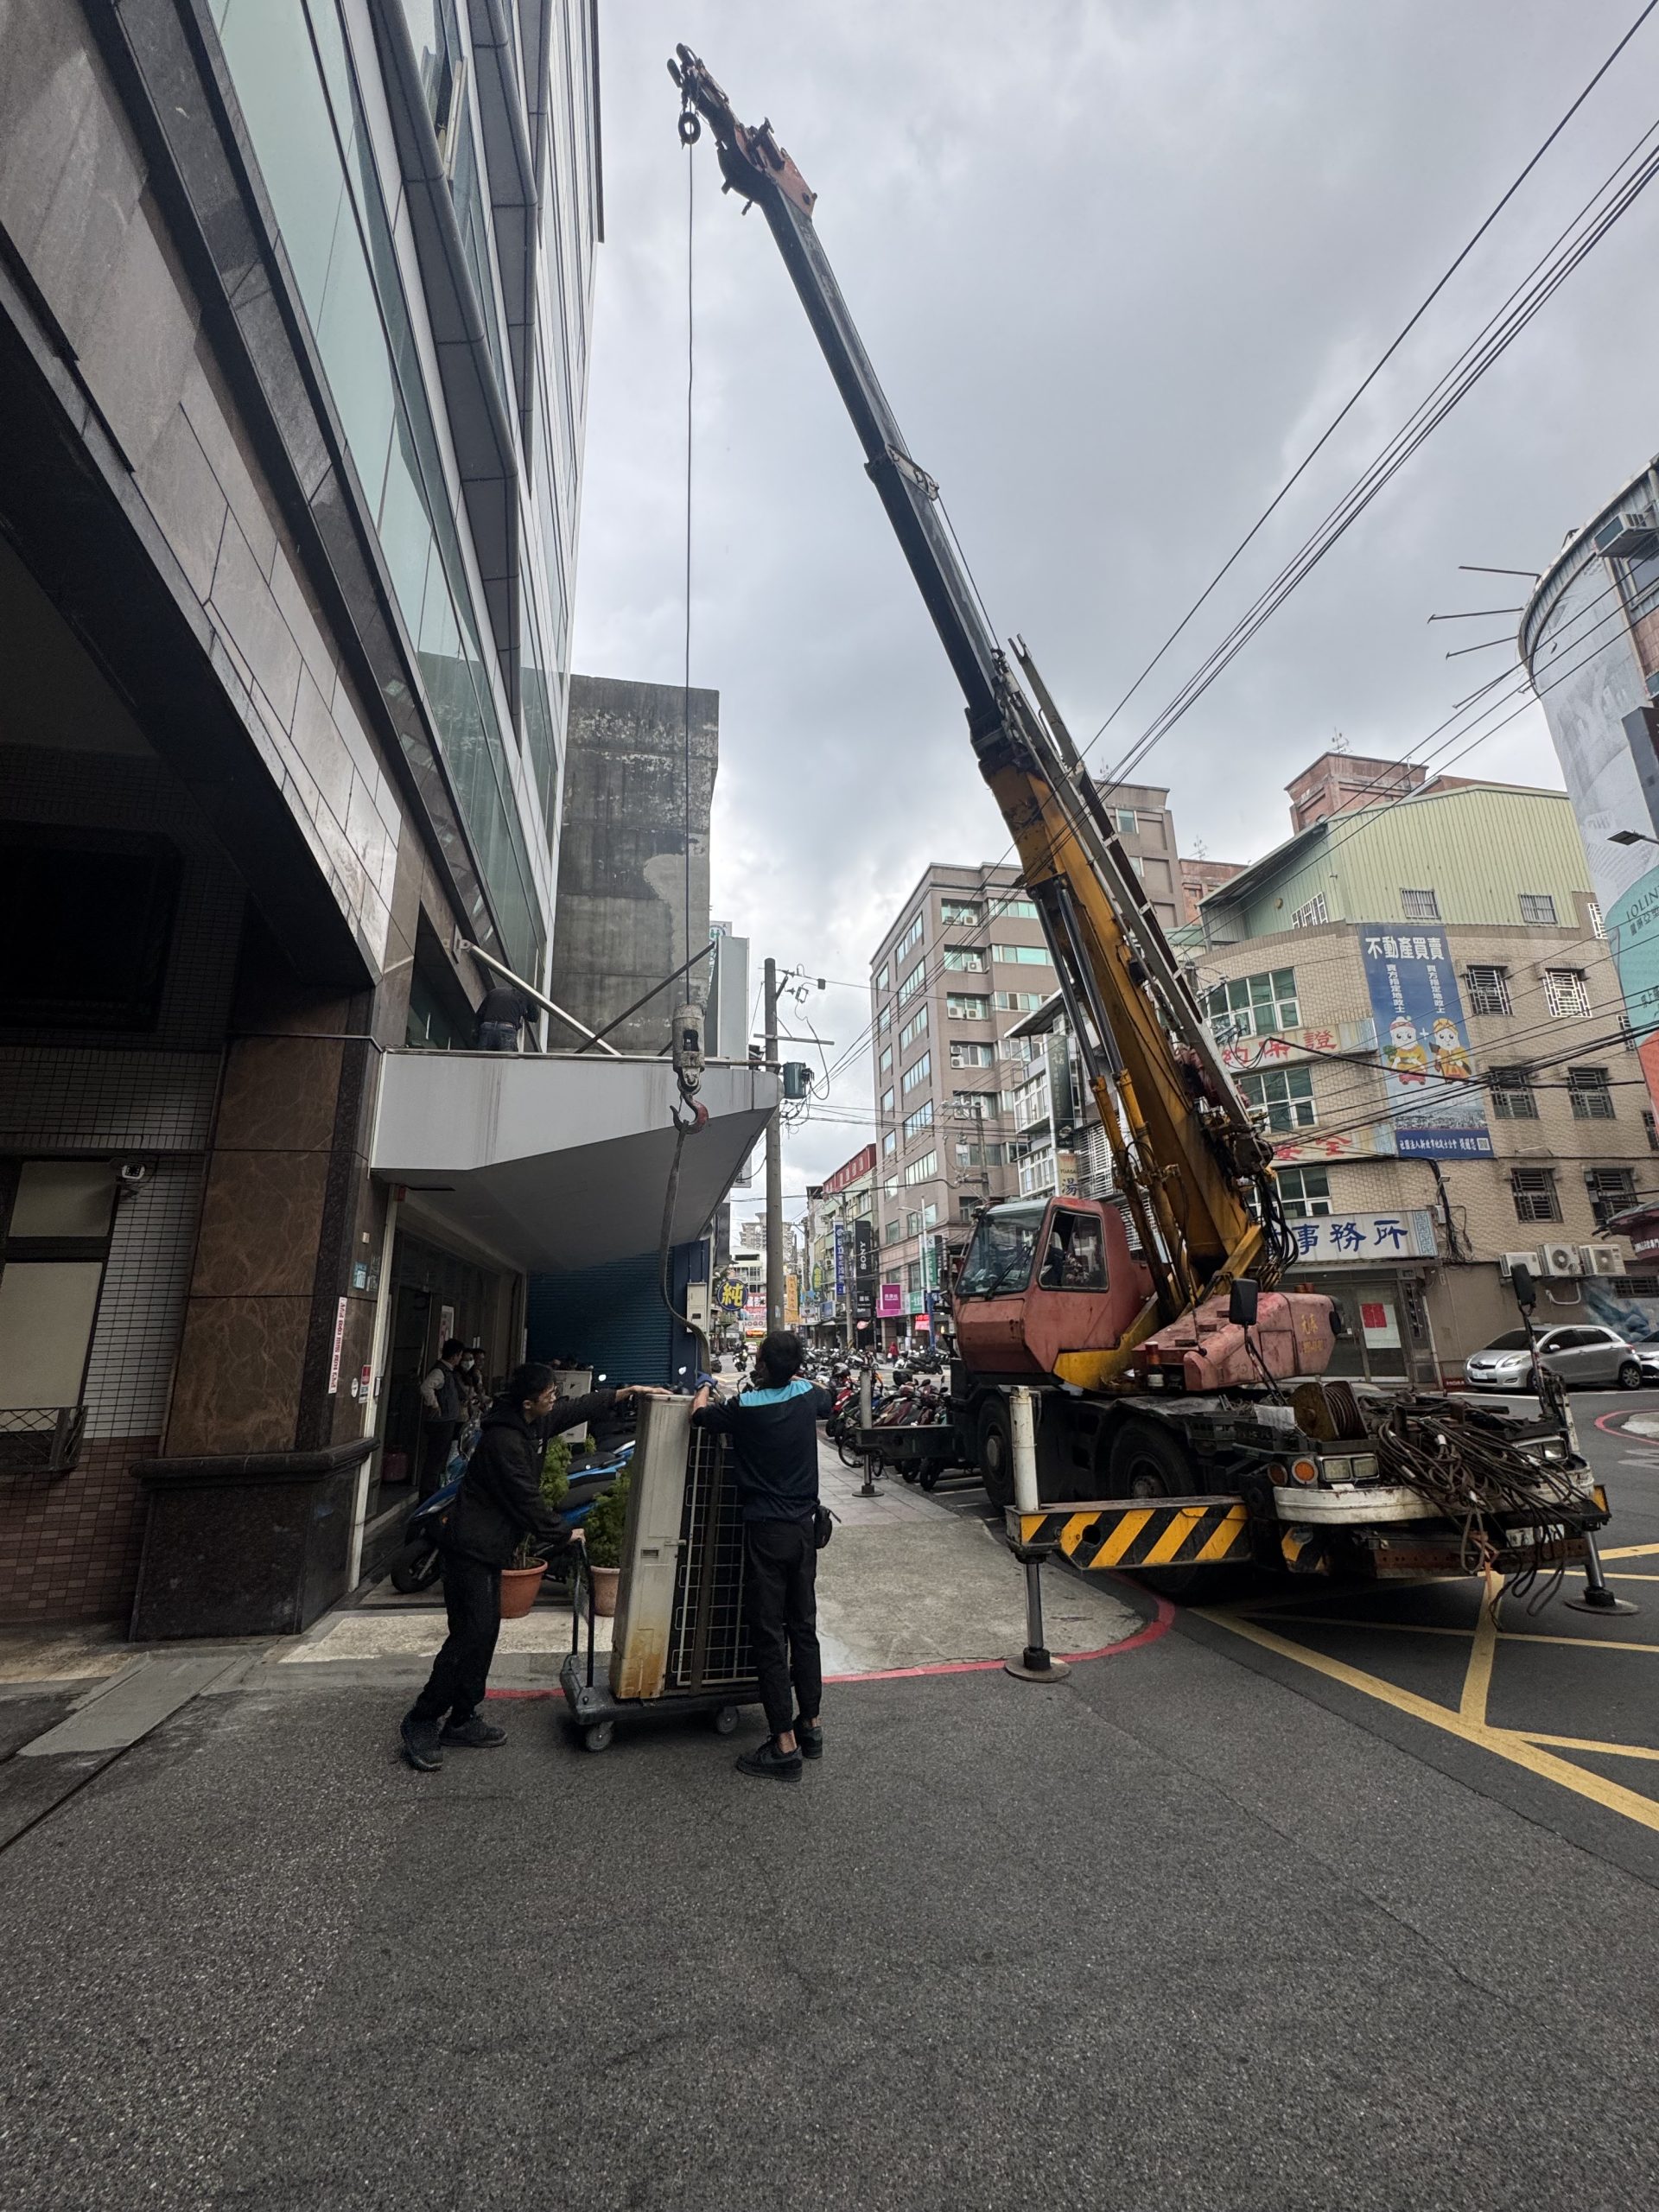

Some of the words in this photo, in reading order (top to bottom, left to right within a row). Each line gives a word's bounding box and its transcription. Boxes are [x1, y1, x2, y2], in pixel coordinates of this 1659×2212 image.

[1625, 885, 1659, 922] JOLIN
[1365, 936, 1445, 960] 不動產買賣
[1274, 1219, 1408, 1255] 事務所
[721, 1282, 744, 1307] 純
